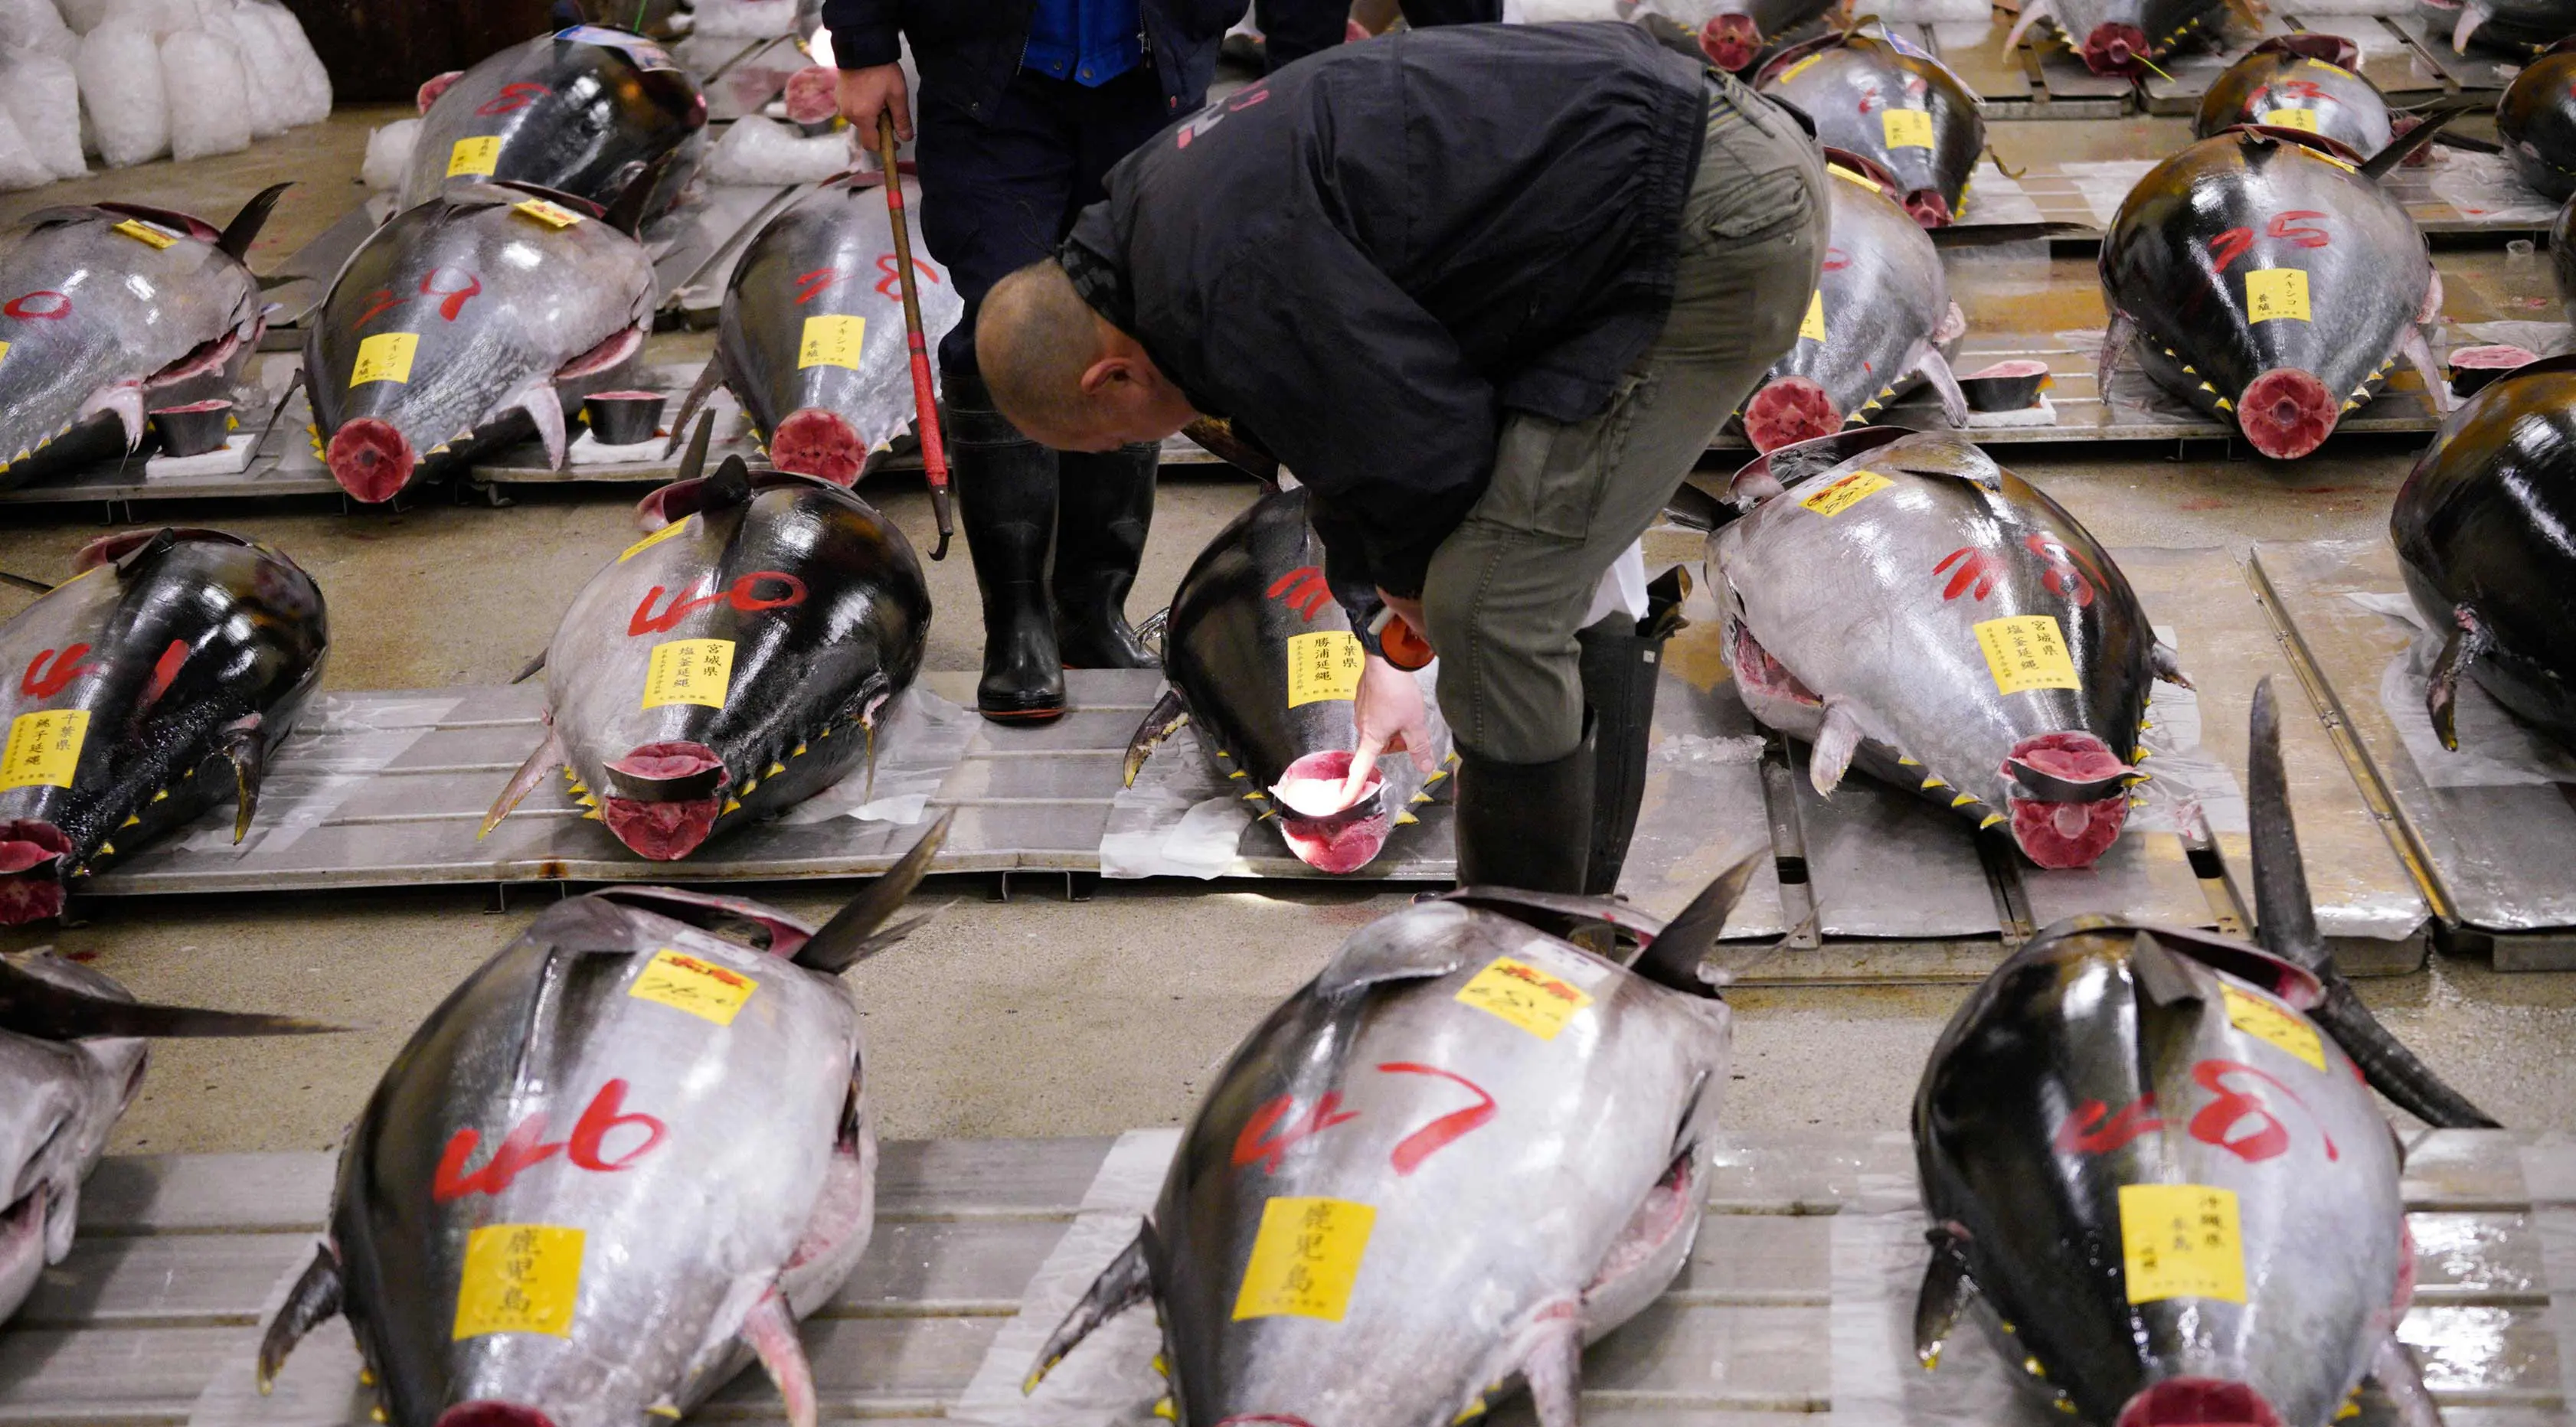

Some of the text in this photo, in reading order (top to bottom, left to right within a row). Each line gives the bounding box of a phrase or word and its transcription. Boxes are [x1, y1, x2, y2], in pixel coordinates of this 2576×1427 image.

[2284, 273, 2296, 305] メキシコ
[835, 320, 848, 352] メキシコ
[627, 570, 807, 636] 40
[704, 644, 724, 677] 宮城県
[1341, 634, 1358, 668] 千葉県
[2032, 620, 2058, 656] 宮城県
[55, 713, 78, 751] 千葉県
[1231, 1062, 1499, 1177] 47
[2051, 1058, 2339, 1164] 48
[433, 1078, 668, 1203] 46
[499, 1228, 542, 1313] 鹿児島
[1280, 1200, 1335, 1294] 鹿児島
